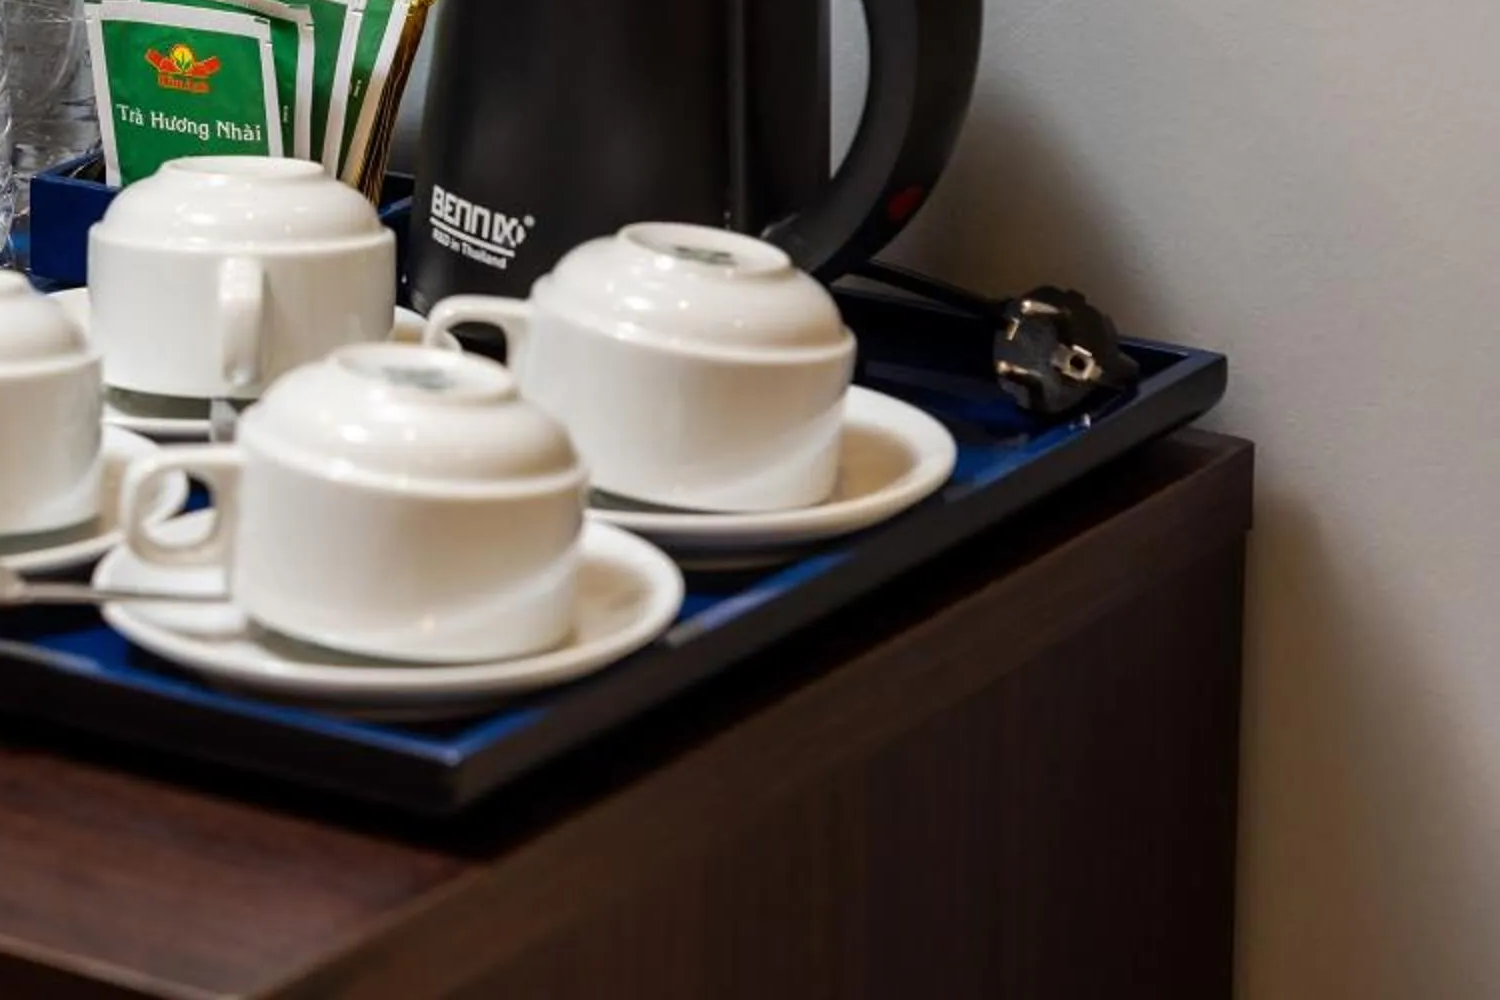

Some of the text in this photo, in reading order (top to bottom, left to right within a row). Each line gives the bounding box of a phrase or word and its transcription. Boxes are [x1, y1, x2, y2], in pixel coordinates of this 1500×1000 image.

[116, 103, 261, 141] Trà Hương Nhài
